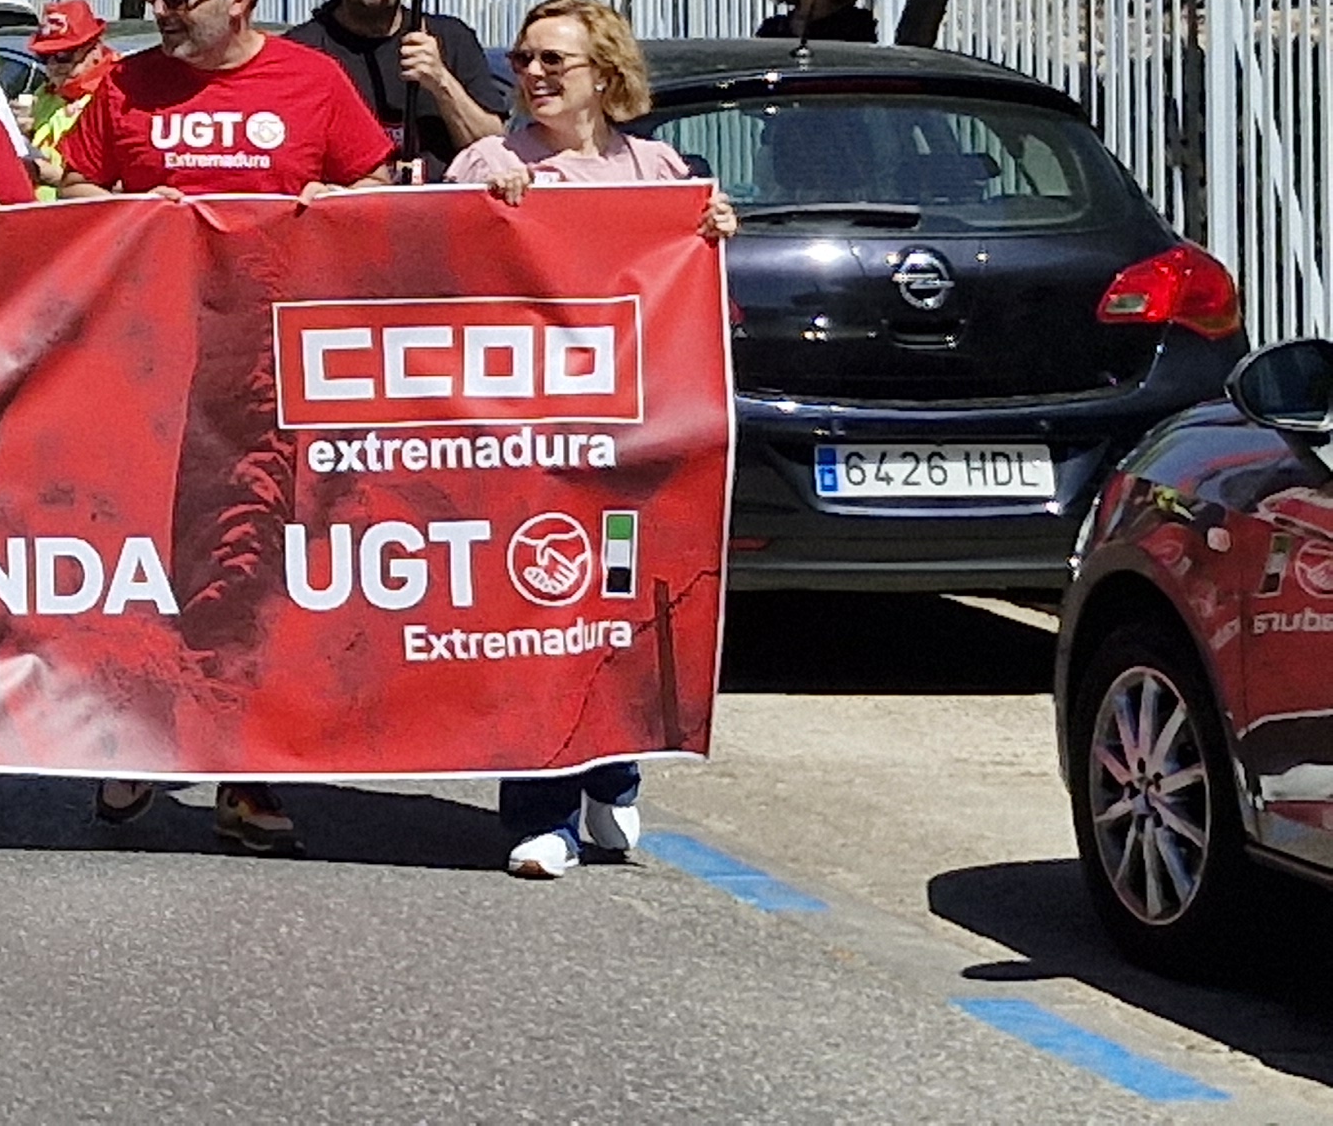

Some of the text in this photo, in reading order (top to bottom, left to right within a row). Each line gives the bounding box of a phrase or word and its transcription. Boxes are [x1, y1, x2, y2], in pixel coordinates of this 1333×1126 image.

[151, 111, 244, 150] UGT
[164, 150, 271, 169] Extremadura
[303, 326, 616, 400] CCOO
[308, 429, 616, 473] extremadura
[844, 451, 1039, 487] 6426 HDL
[284, 520, 492, 612] UGT
[404, 619, 632, 661] Extremadura
